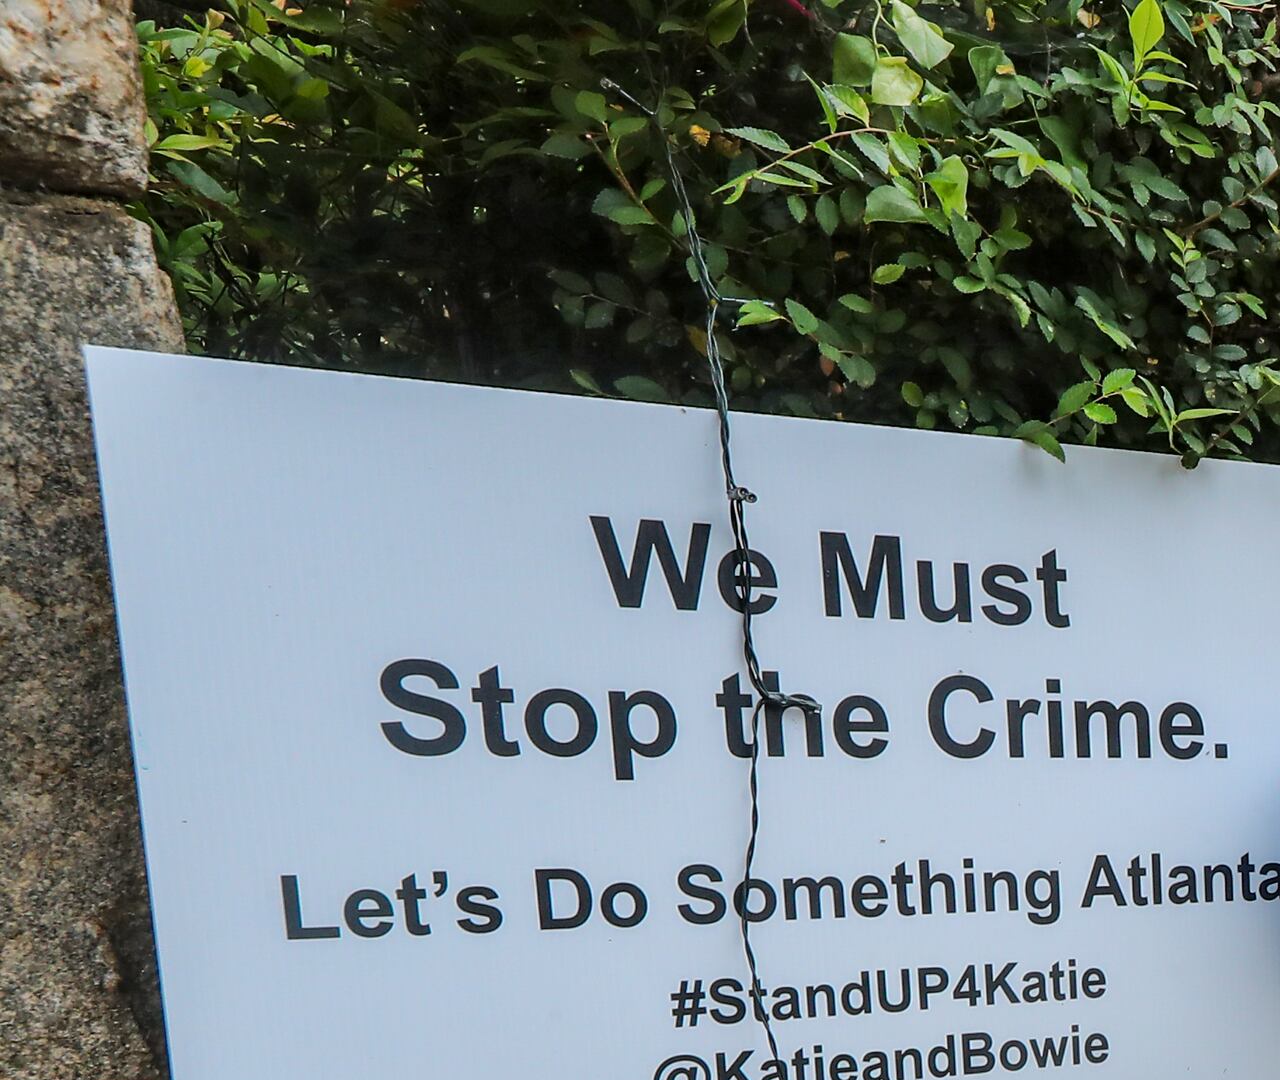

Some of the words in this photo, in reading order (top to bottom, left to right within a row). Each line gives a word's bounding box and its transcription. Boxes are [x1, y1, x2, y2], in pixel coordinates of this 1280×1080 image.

[590, 515, 778, 617] We
[820, 531, 1070, 628] Must
[380, 659, 677, 780] Stop
[717, 671, 890, 758] the
[928, 675, 1227, 760] Crime.
[281, 871, 502, 940] Let’s
[535, 869, 647, 930] Do
[677, 855, 1063, 930] Something
[670, 958, 1108, 1029] #StandUP4Katie
